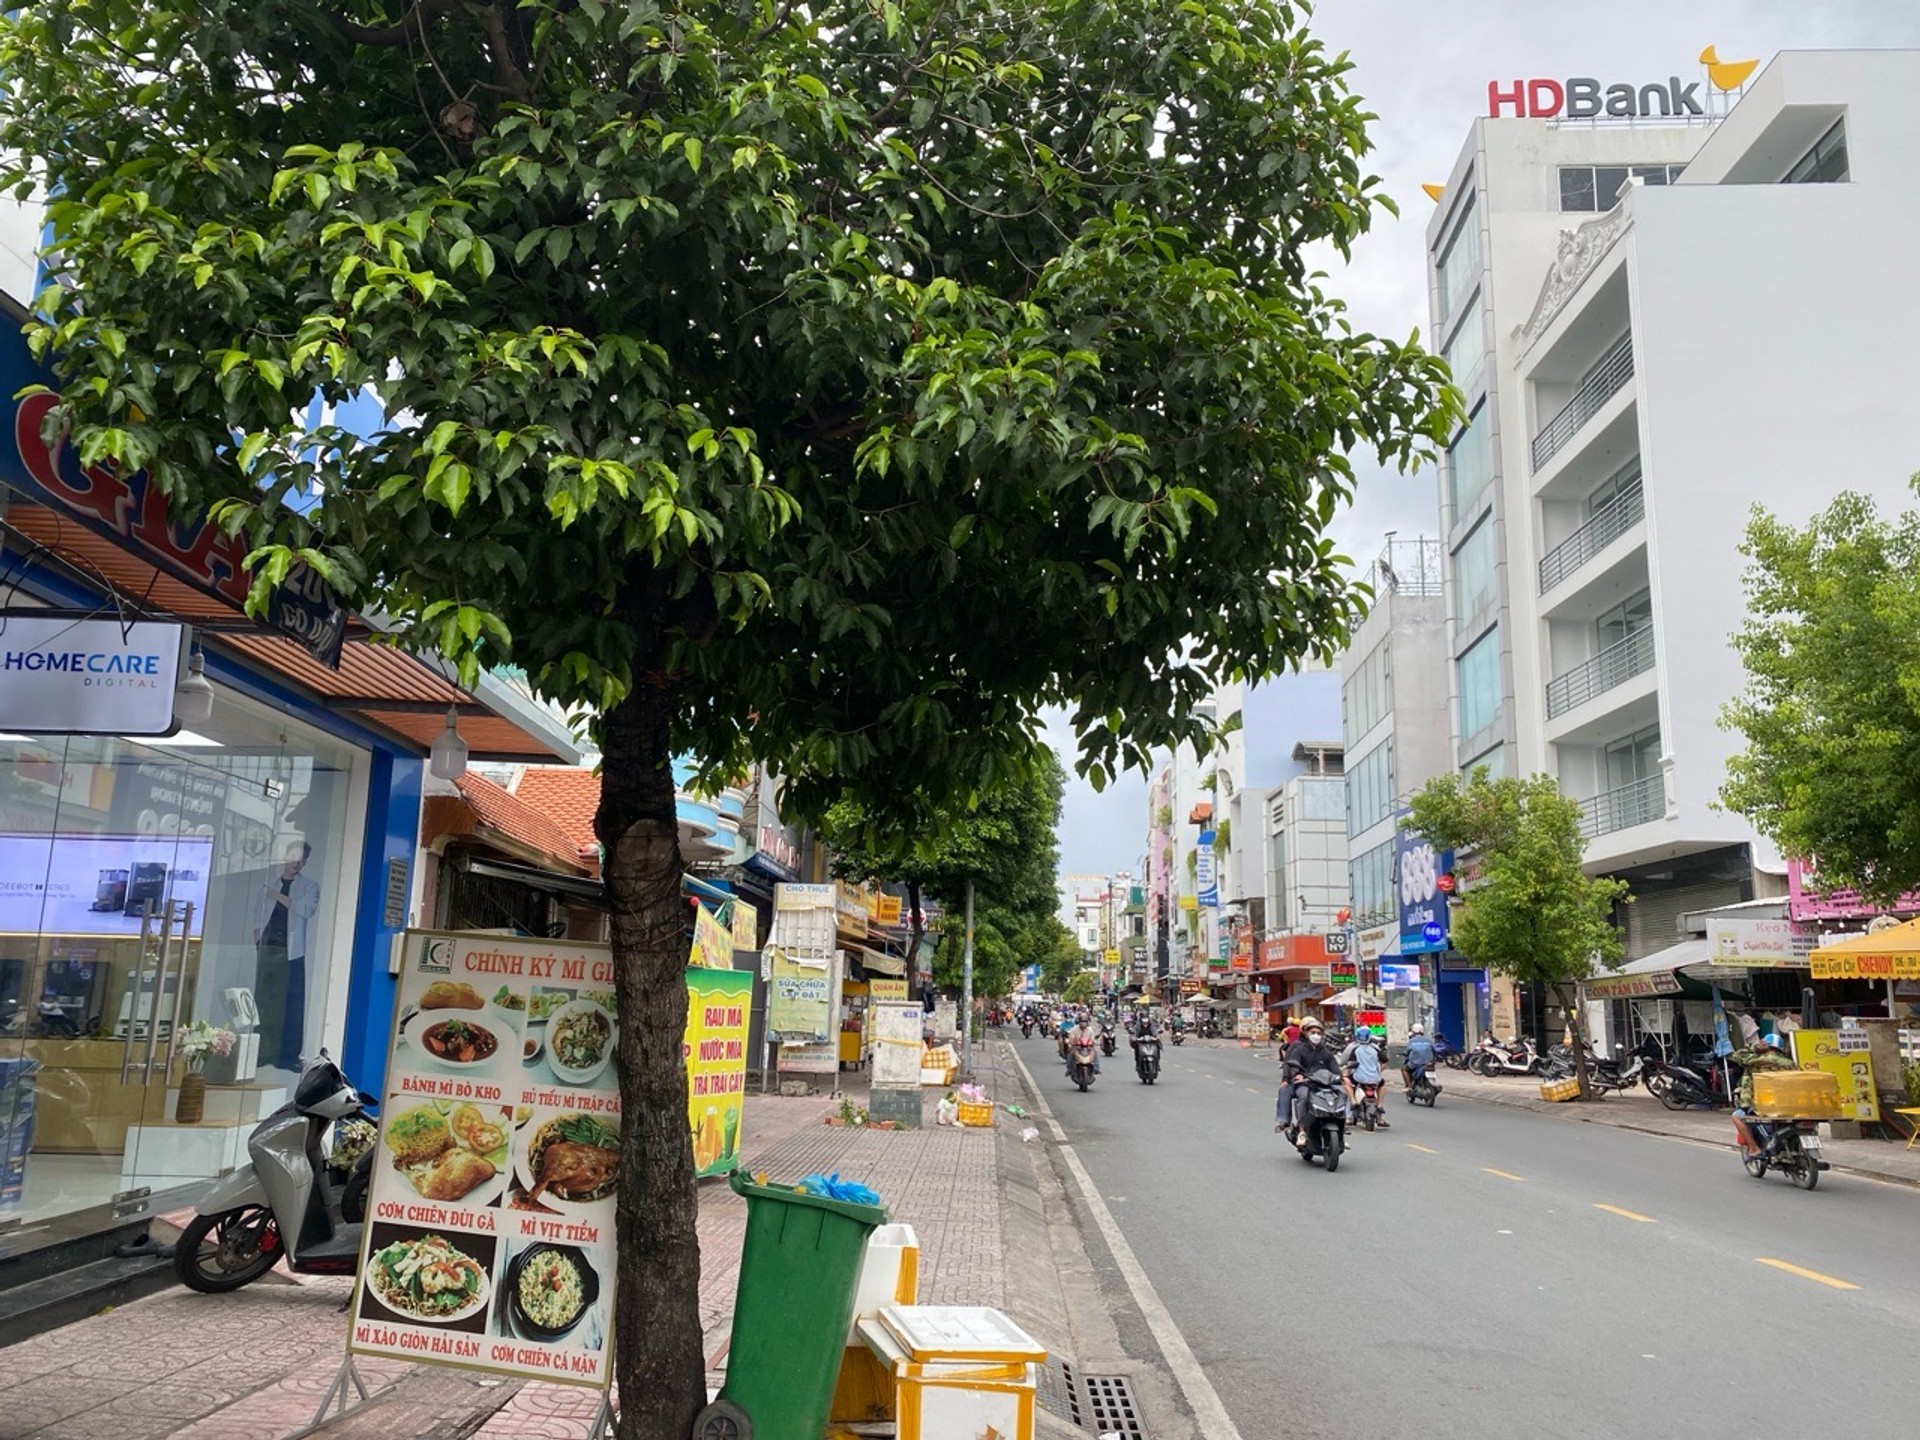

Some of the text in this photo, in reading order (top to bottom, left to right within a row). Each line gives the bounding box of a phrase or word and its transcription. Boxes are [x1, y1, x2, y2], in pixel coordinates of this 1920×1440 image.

[1488, 76, 1704, 118] HDBank
[5, 652, 160, 674] HOMECARE
[84, 678, 157, 688] DIGITAL
[464, 949, 525, 976] CHÍNH
[529, 953, 556, 978] KÝ
[561, 956, 586, 981] MÌ
[592, 961, 616, 983] GI
[704, 1007, 725, 1027] RAU
[699, 1038, 724, 1061] NƯỚC
[402, 1076, 502, 1100] BÁNH MÌ BÒ KHO
[693, 1072, 708, 1096] TRÀ
[710, 1072, 728, 1095] TRÁI
[521, 1087, 536, 1104] HỦ
[538, 1088, 562, 1107] TIẾU
[563, 1093, 576, 1108] MÌ
[577, 1095, 604, 1114] THẬP
[376, 1201, 496, 1231] CƠM CHIÊN ĐÙI GÀ
[520, 1217, 599, 1242] MÌ VỊT TIỀM
[355, 1323, 480, 1357] MÌ XÀO GIÒN HẢI SẢN
[491, 1344, 597, 1377] CƠM CHIÊN CÁ MẶN
